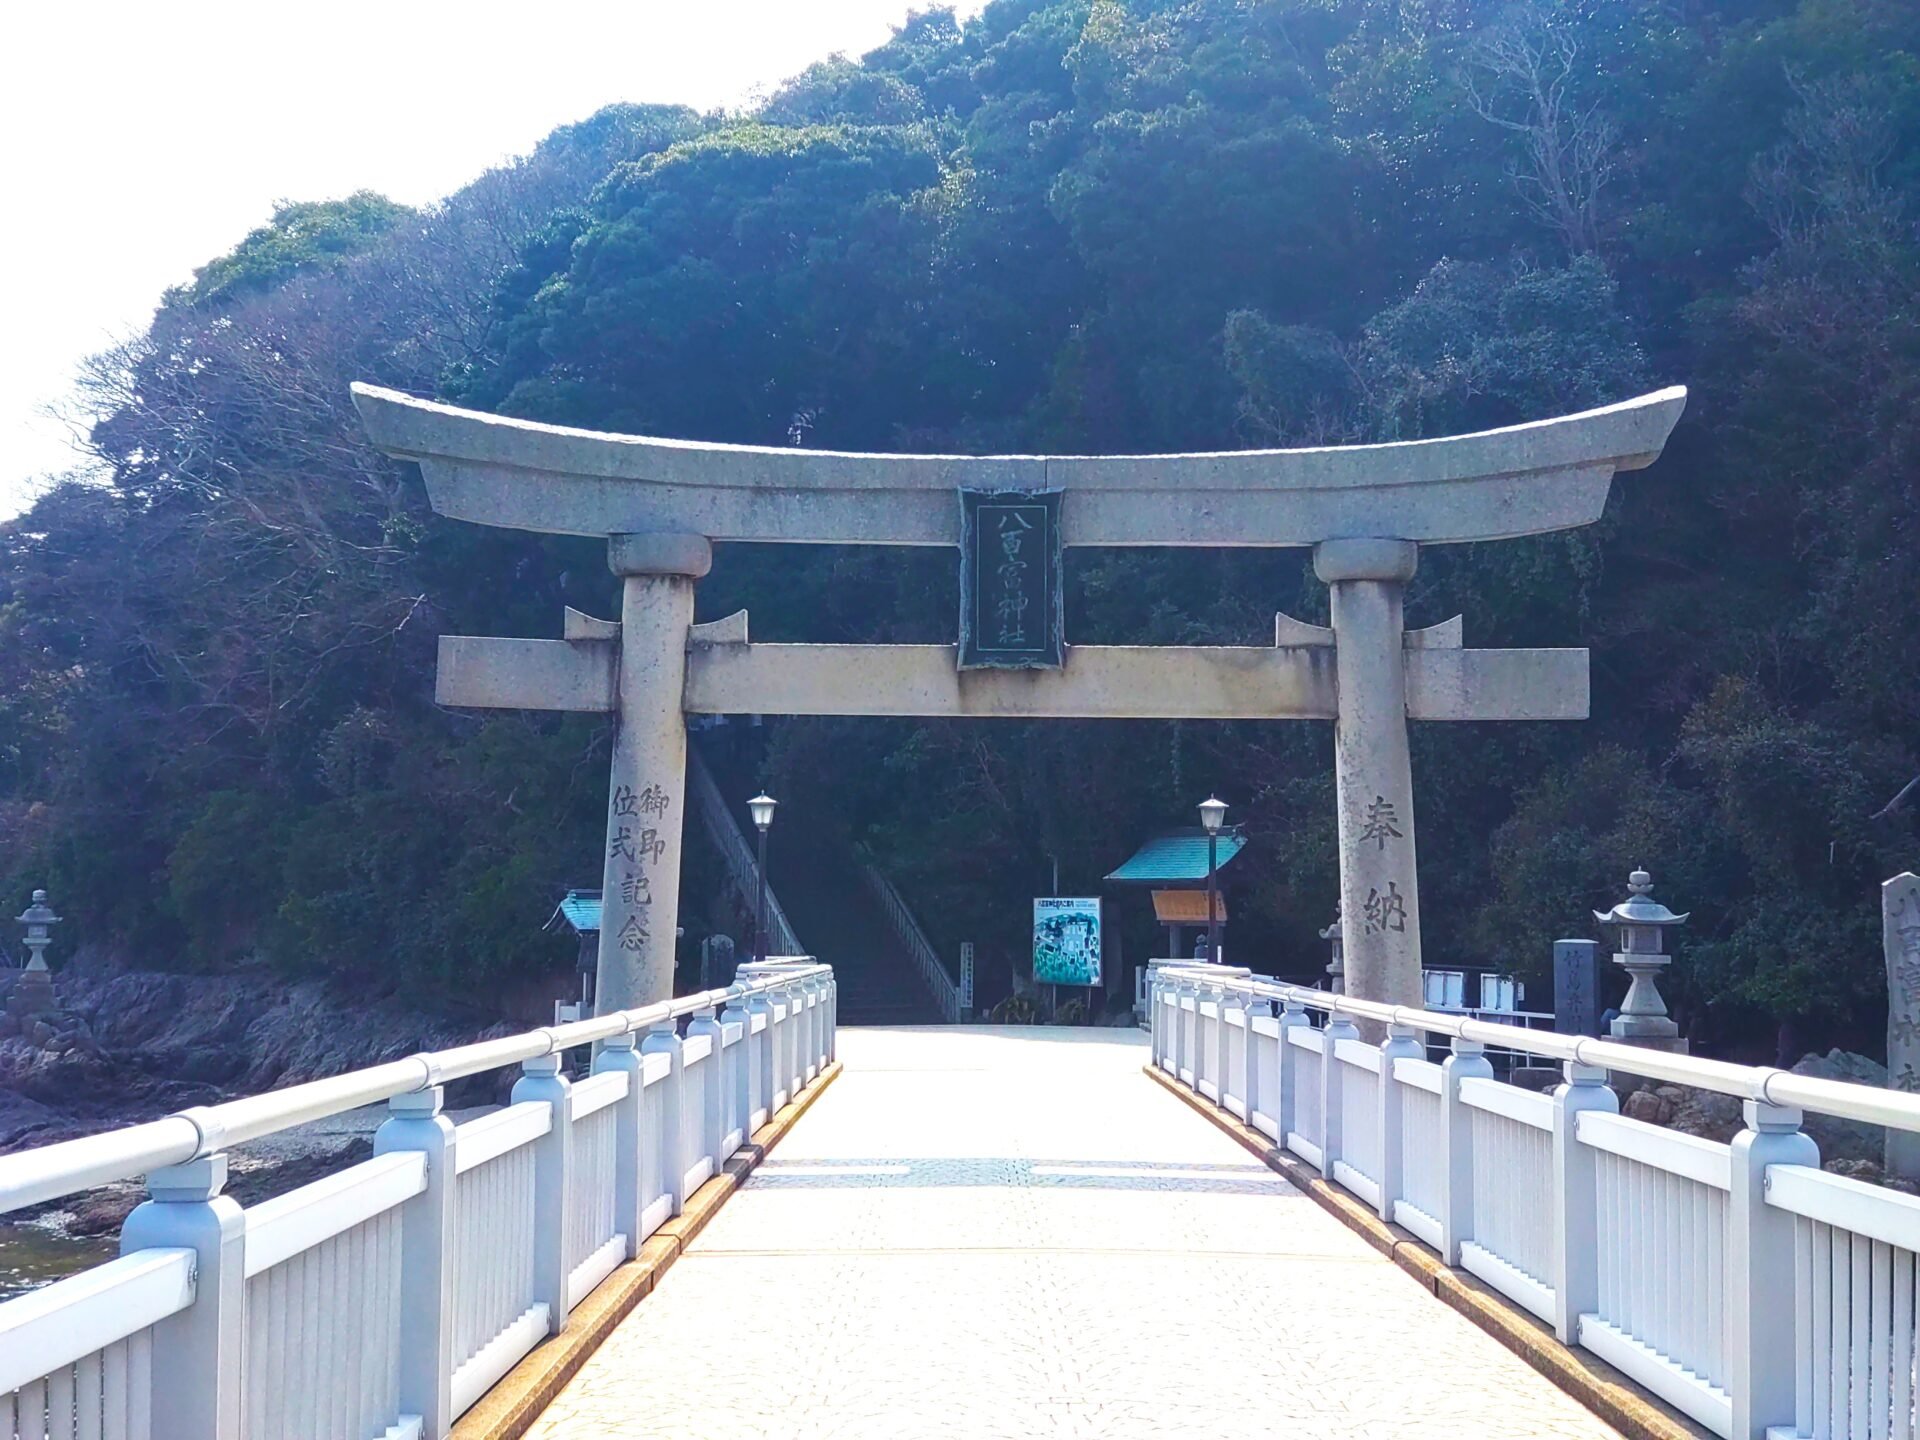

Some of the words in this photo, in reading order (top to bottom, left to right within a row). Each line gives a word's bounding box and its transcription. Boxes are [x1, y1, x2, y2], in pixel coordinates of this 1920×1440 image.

[996, 511, 1033, 644] 八百富神社
[1358, 795, 1408, 935] 奉納
